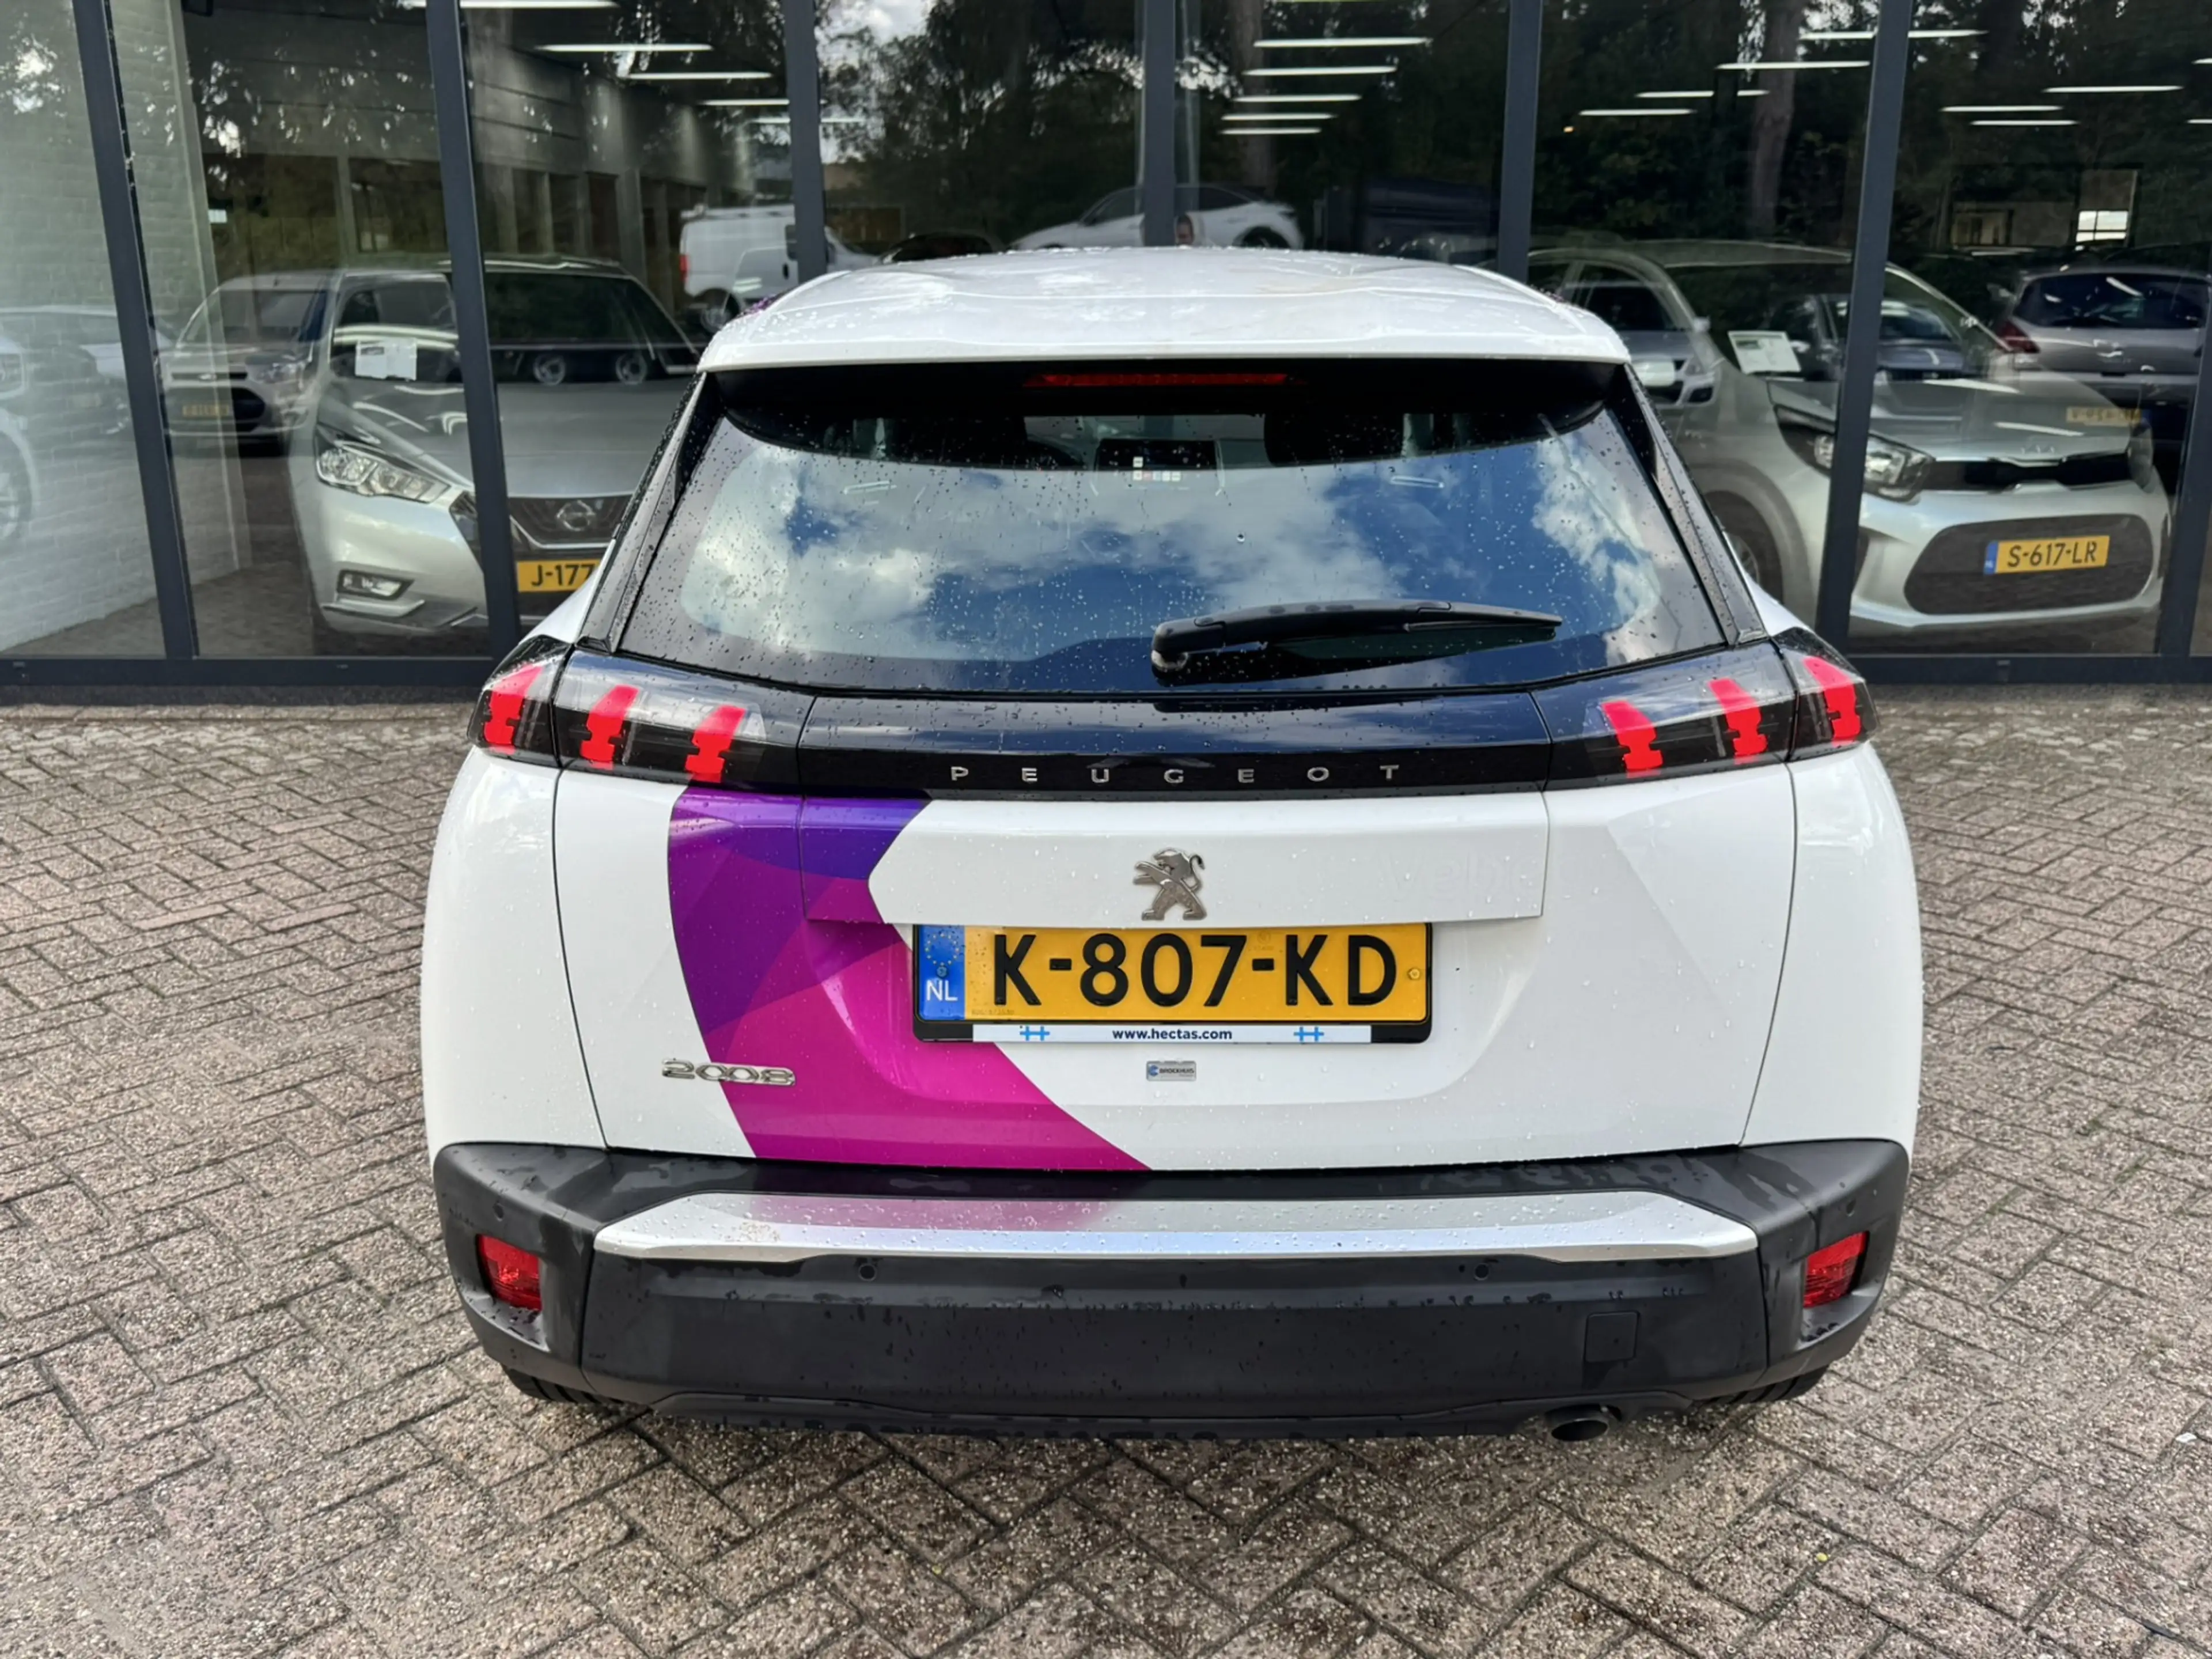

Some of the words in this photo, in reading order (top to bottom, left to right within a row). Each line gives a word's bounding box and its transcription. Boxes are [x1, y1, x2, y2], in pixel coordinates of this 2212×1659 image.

[2007, 541, 2097, 567] S-617-LR
[950, 764, 1400, 784] PEUGEOT
[994, 933, 1397, 1007] K-807-KD
[926, 979, 958, 1001] NL
[1112, 1028, 1233, 1039] www.hectas.com
[662, 1059, 796, 1086] 2008
